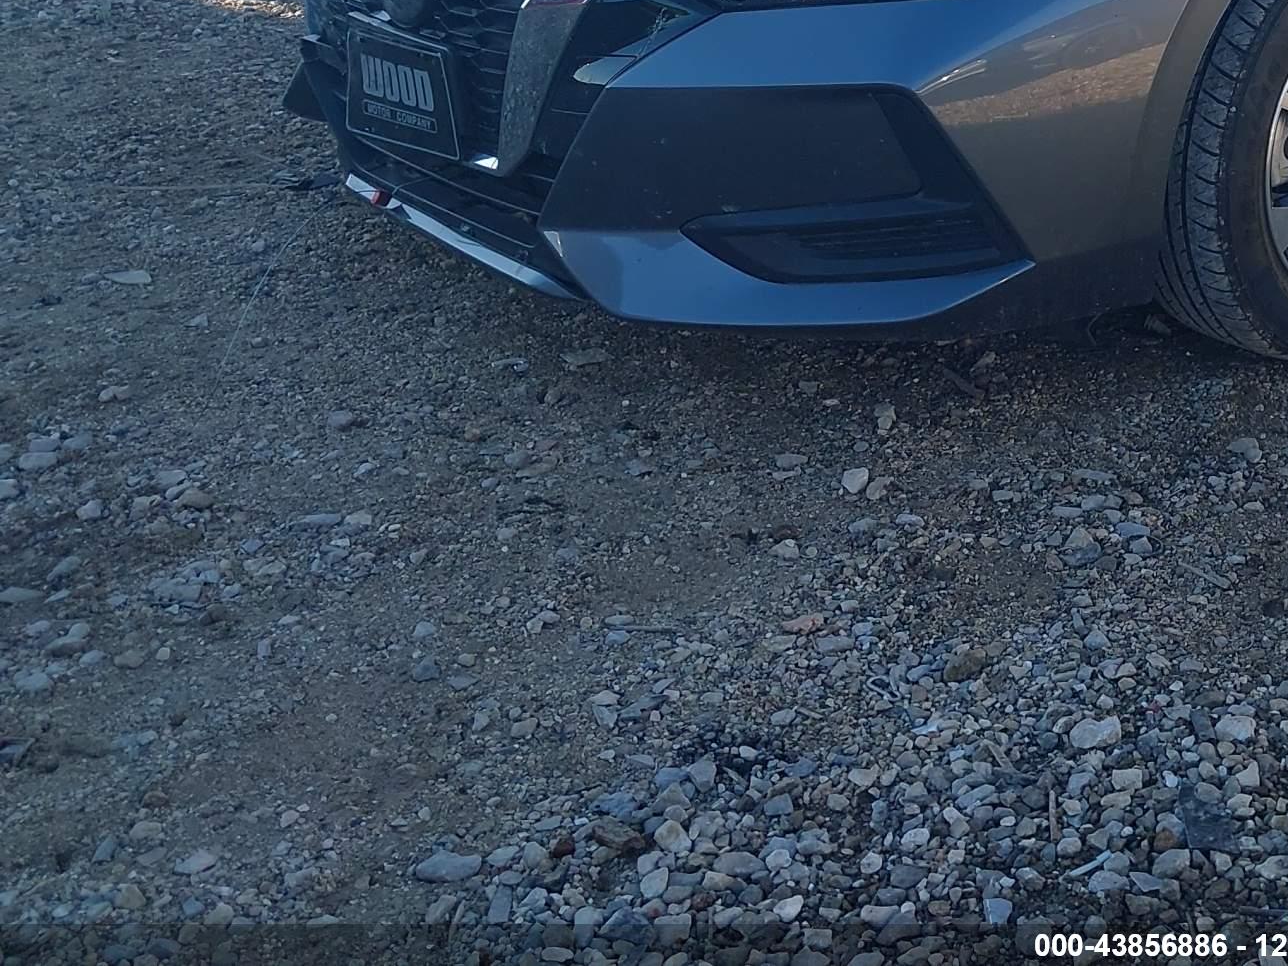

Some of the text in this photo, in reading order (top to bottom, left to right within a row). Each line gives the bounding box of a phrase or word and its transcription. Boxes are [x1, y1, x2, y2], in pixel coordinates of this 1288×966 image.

[360, 53, 434, 112] WOOD
[367, 102, 432, 130] MOTOR COMPANY
